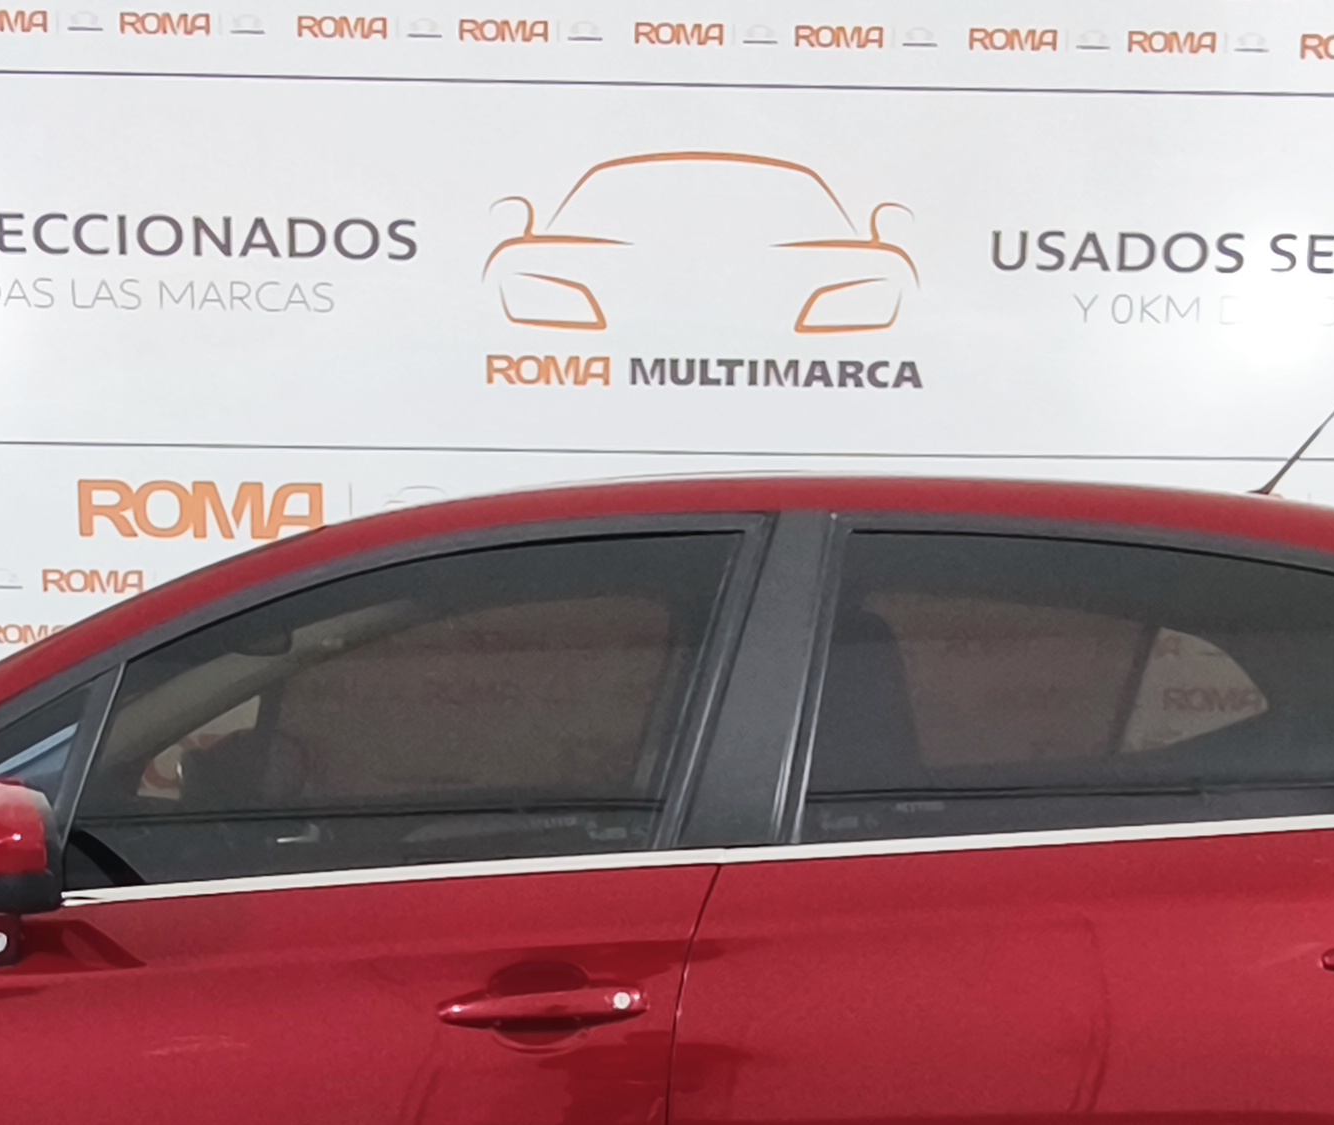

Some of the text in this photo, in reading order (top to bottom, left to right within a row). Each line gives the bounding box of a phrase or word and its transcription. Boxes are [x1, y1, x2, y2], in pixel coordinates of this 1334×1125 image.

[119, 12, 211, 36] ROMA
[296, 16, 388, 40] ROMA
[459, 19, 549, 43] ROMA
[634, 22, 724, 46] ROMA
[794, 25, 883, 48] ROMA
[969, 27, 1057, 51] ROMA
[1127, 30, 1216, 54] ROMA
[992, 230, 1245, 273] USADOS
[71, 279, 142, 310] LAS
[159, 280, 335, 313] MARCAS
[1073, 294, 1099, 323] Y
[486, 355, 923, 388] ROMA MULTIMARCA
[77, 479, 324, 540] ROMA
[42, 569, 144, 593] ROMA
